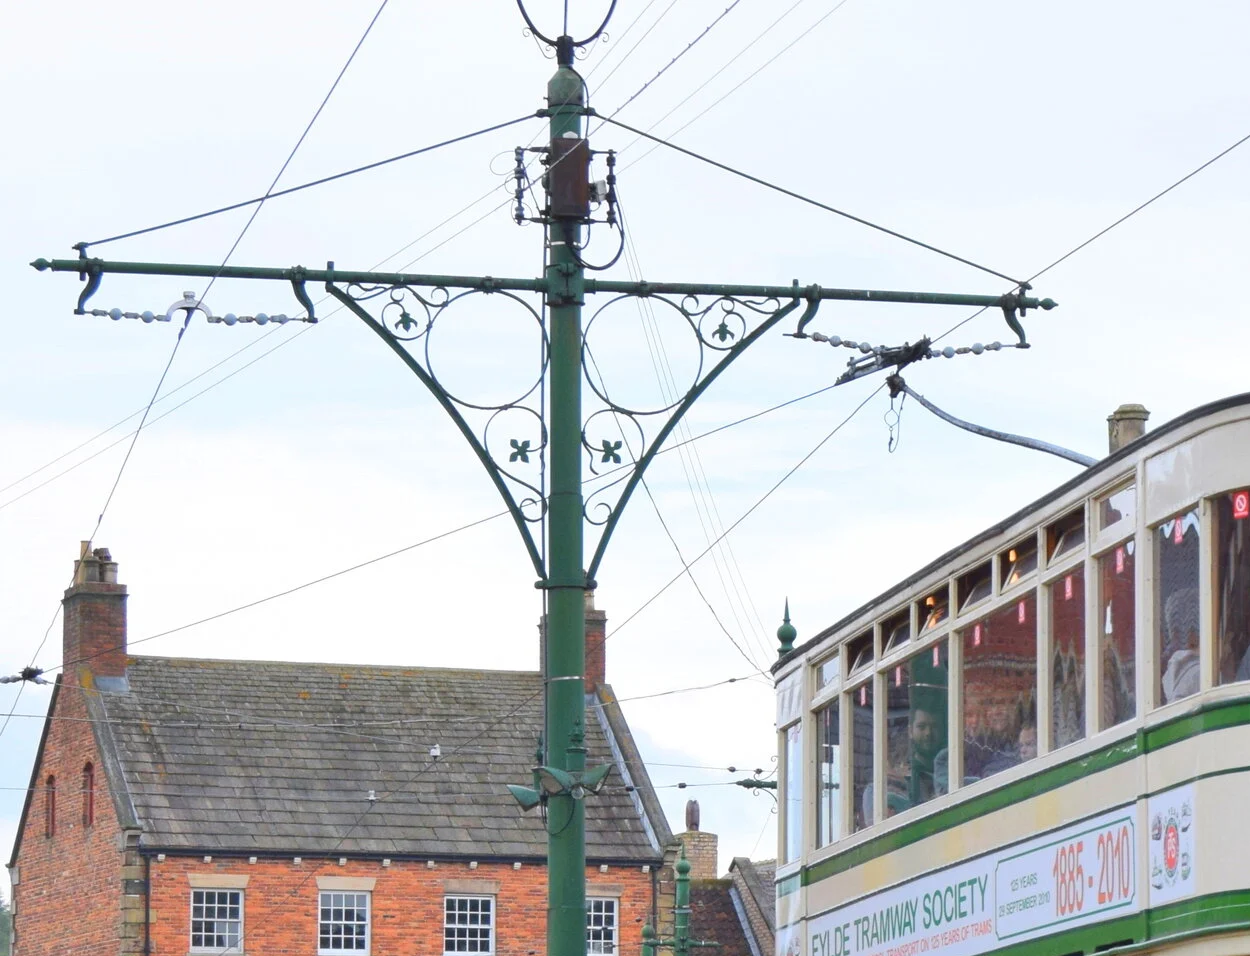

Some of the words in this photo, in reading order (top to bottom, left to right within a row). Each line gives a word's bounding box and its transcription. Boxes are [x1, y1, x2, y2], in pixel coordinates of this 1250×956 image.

[1020, 872, 1038, 889] YEARS
[1053, 841, 1084, 917] 1885
[1097, 825, 1130, 905] 2010
[854, 897, 918, 952] TRAMWAY
[923, 874, 988, 929] SOCIETY
[1006, 894, 1038, 914] SEPTEMBER
[920, 938, 929, 954] ON
[930, 935, 940, 950] 125
[940, 929, 960, 948] YEARS
[960, 926, 970, 942] OF
[971, 919, 992, 938] TRAMS
